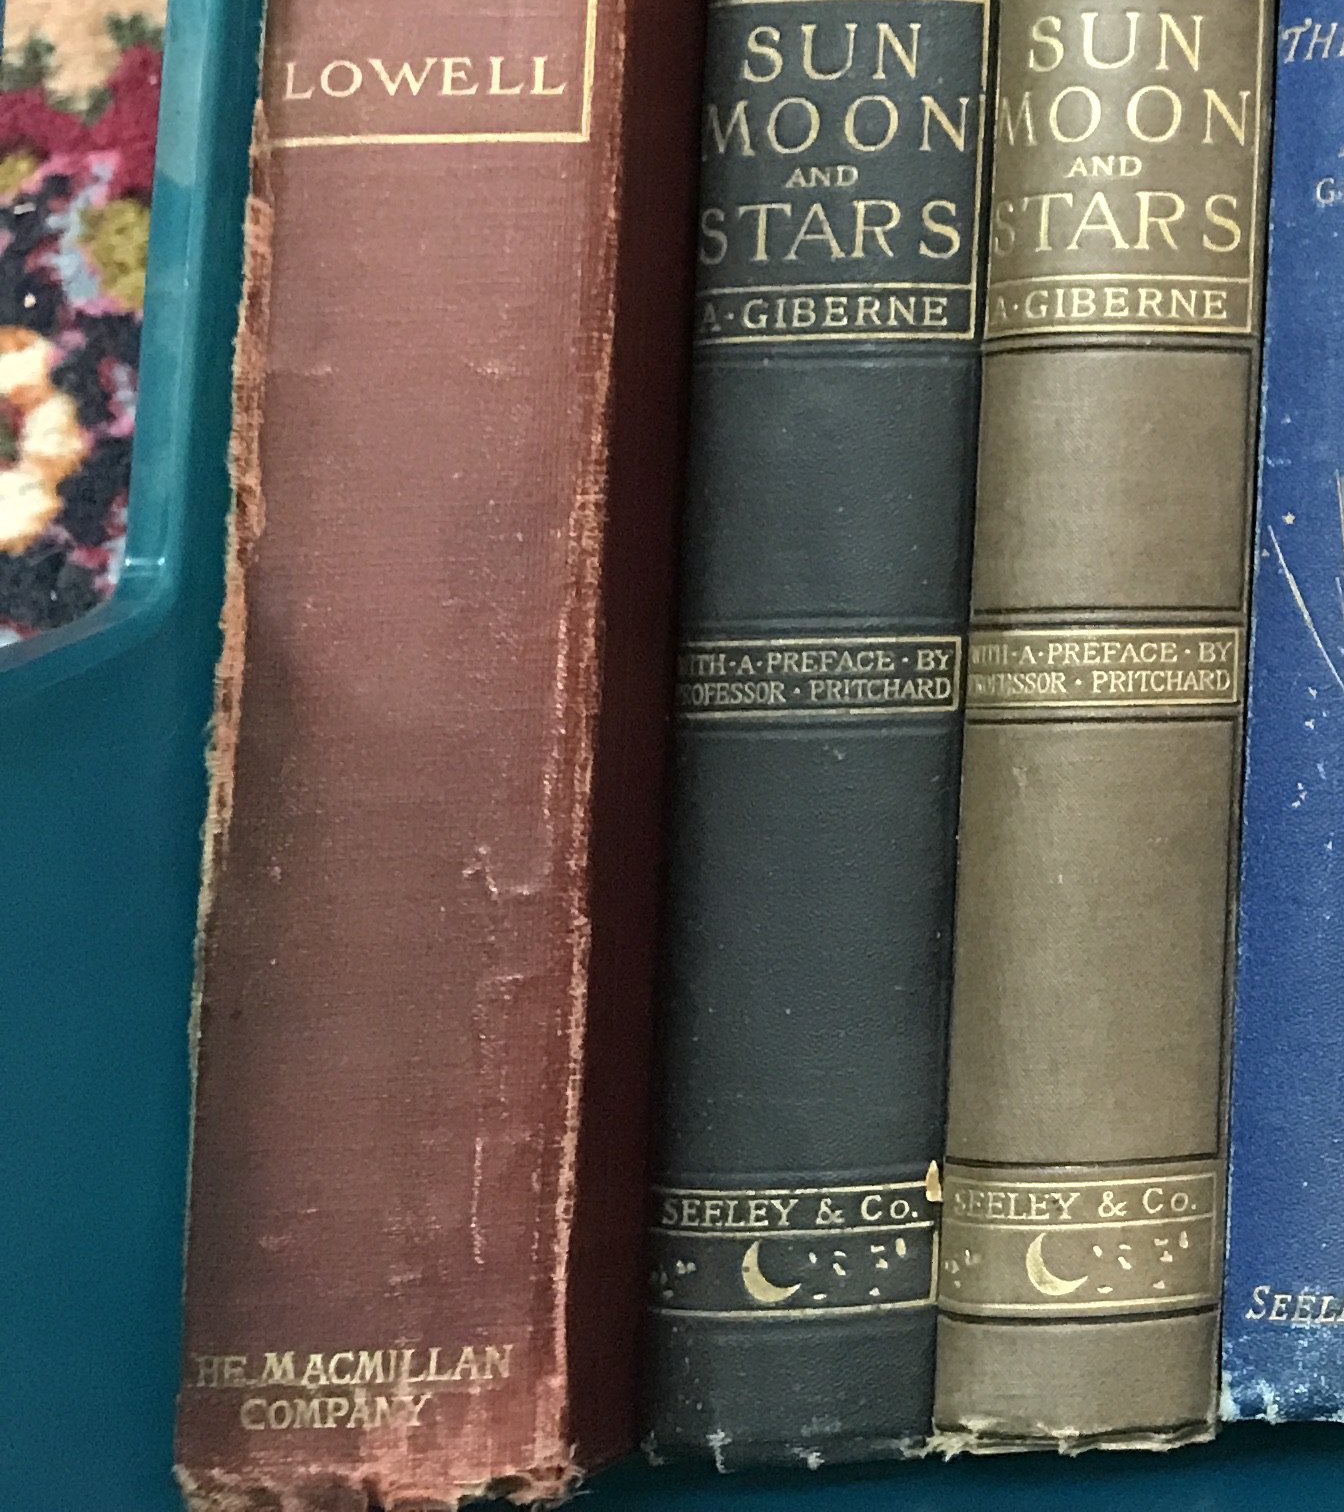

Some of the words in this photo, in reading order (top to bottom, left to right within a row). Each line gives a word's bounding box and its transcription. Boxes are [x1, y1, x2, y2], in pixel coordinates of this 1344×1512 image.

[741, 22, 921, 83] SUN
[1027, 11, 1204, 72] SUN
[283, 56, 566, 100] LOWELL
[703, 95, 969, 157] MOON
[1001, 85, 1251, 148] MOON
[783, 165, 860, 188] AND
[1065, 156, 1143, 179] AND
[700, 199, 962, 265] STARS
[996, 191, 1242, 255] STARS
[742, 296, 948, 330] GIBERNE
[1024, 288, 1229, 321] GIBERNE
[766, 650, 896, 676] PREFACE
[916, 649, 954, 672] BY
[1047, 640, 1178, 667] PREFACE
[1197, 641, 1233, 664] BY
[809, 677, 952, 703] PRITCHARD
[1092, 670, 1232, 694] PRITCHARD
[662, 1197, 799, 1228] SEELEY
[815, 1200, 844, 1226] &
[952, 1189, 1081, 1219] SEELEY
[1097, 1190, 1127, 1217] &
[190, 1353, 248, 1387] HE
[261, 1344, 515, 1386] MACMILLAN
[240, 1390, 434, 1431] COMPANY
